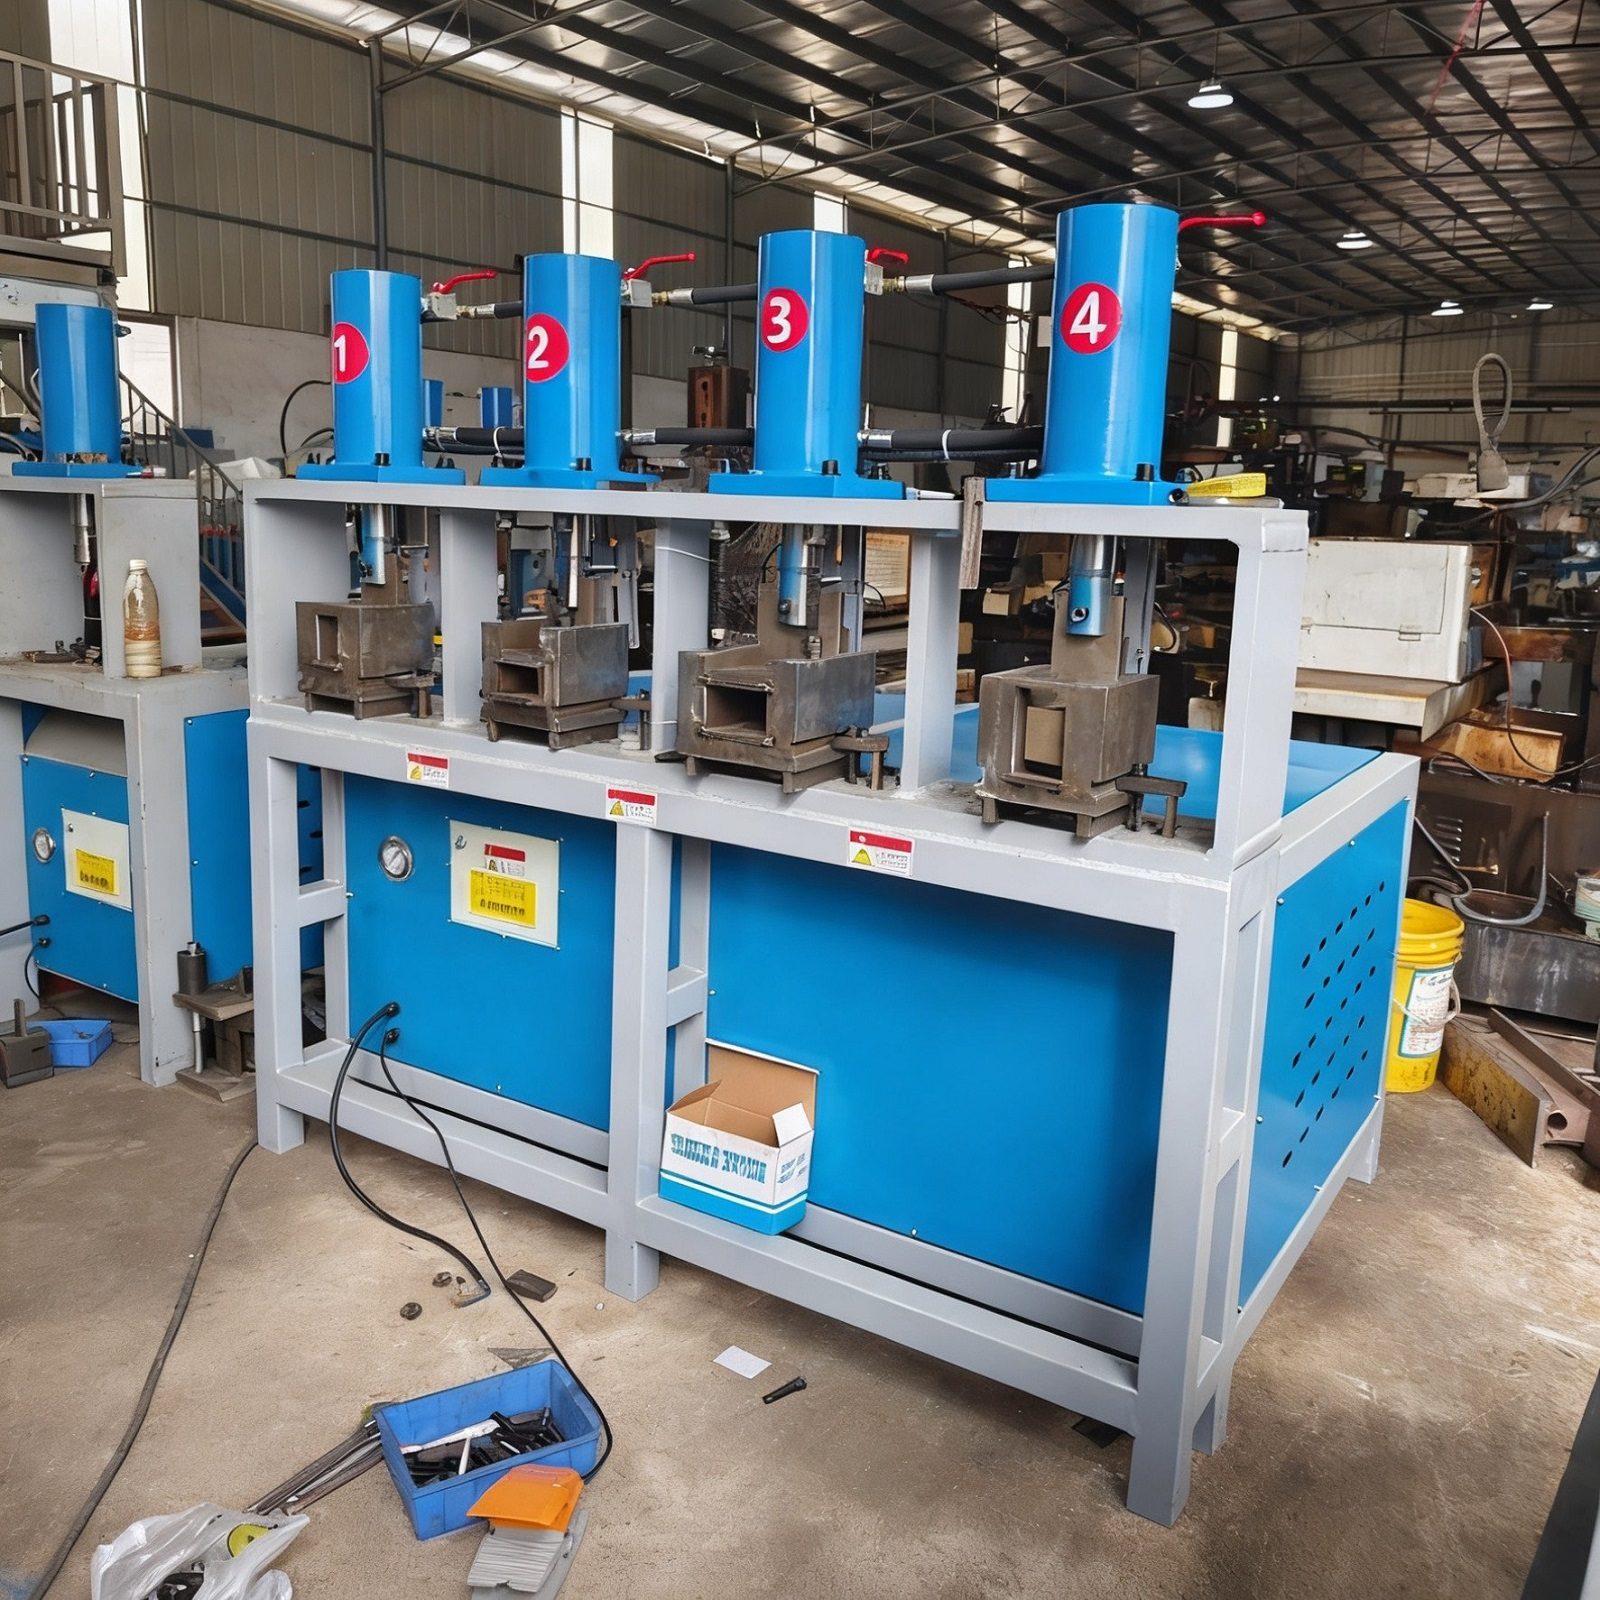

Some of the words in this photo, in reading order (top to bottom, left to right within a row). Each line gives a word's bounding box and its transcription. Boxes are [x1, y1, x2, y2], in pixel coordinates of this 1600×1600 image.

[766, 296, 792, 344] 3
[1069, 291, 1107, 345] 4
[333, 335, 347, 373] 1
[527, 325, 549, 370] 2
